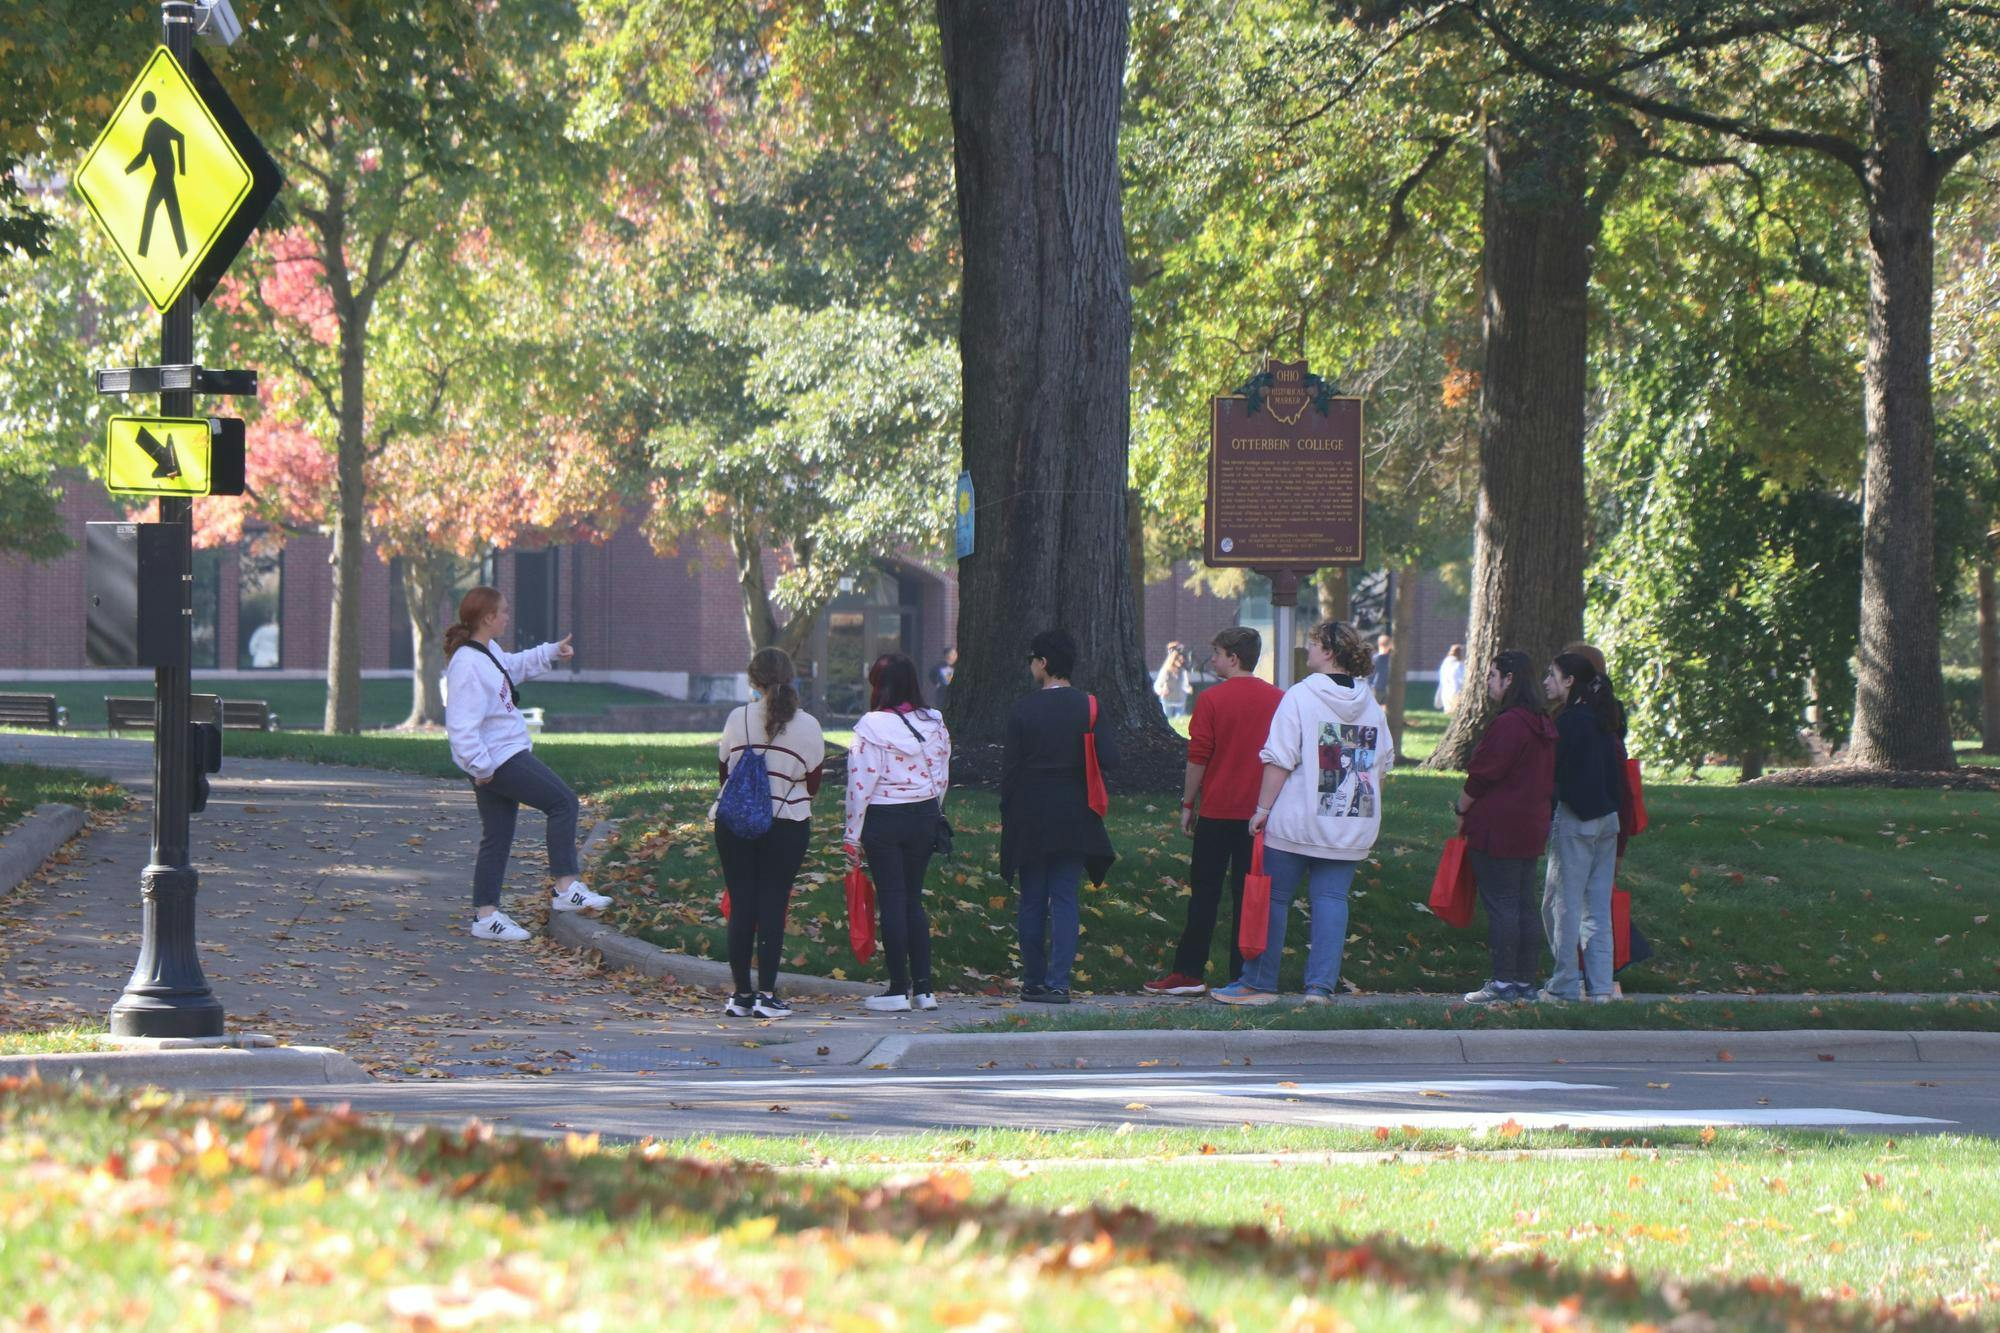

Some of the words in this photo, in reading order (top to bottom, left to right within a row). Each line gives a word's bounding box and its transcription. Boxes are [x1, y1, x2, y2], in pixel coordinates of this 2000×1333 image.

[1276, 370, 1300, 382] OHIO
[1231, 438, 1290, 451] OTTERBEIN
[1297, 438, 1344, 451] COLLEGE
[571, 892, 586, 906] DK
[489, 920, 506, 935] NY
